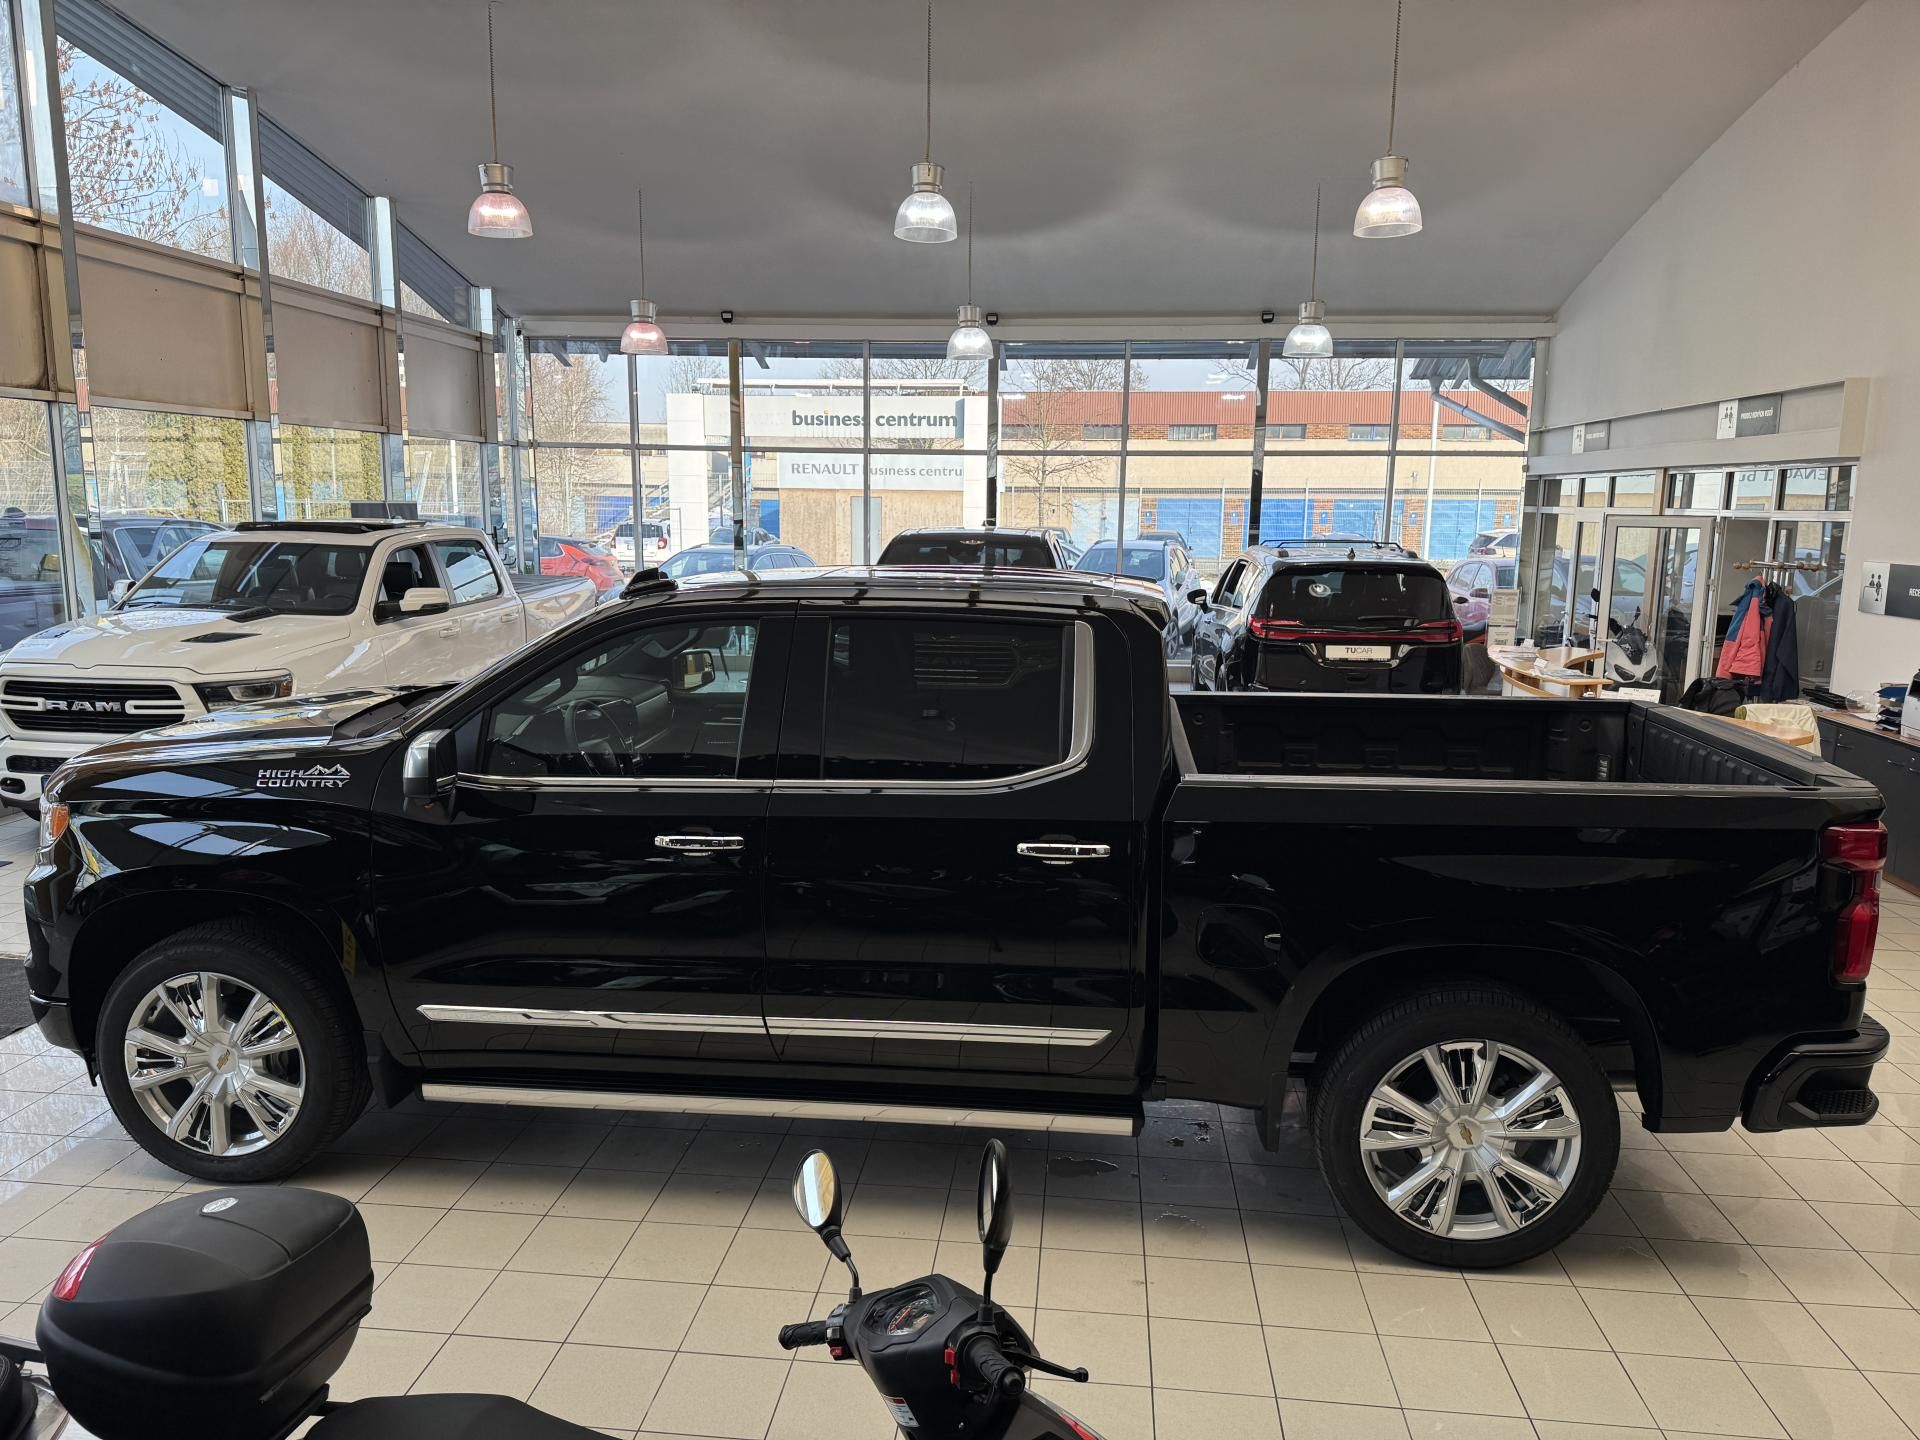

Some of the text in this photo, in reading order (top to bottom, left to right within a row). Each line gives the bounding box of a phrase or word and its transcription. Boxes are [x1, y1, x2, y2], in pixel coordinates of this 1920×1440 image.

[875, 412, 958, 427] centrum
[791, 463, 963, 477] RENAULT usiness centru
[46, 699, 121, 712] RAM
[257, 769, 304, 778] HIGH
[255, 779, 350, 788] COUNTRY
